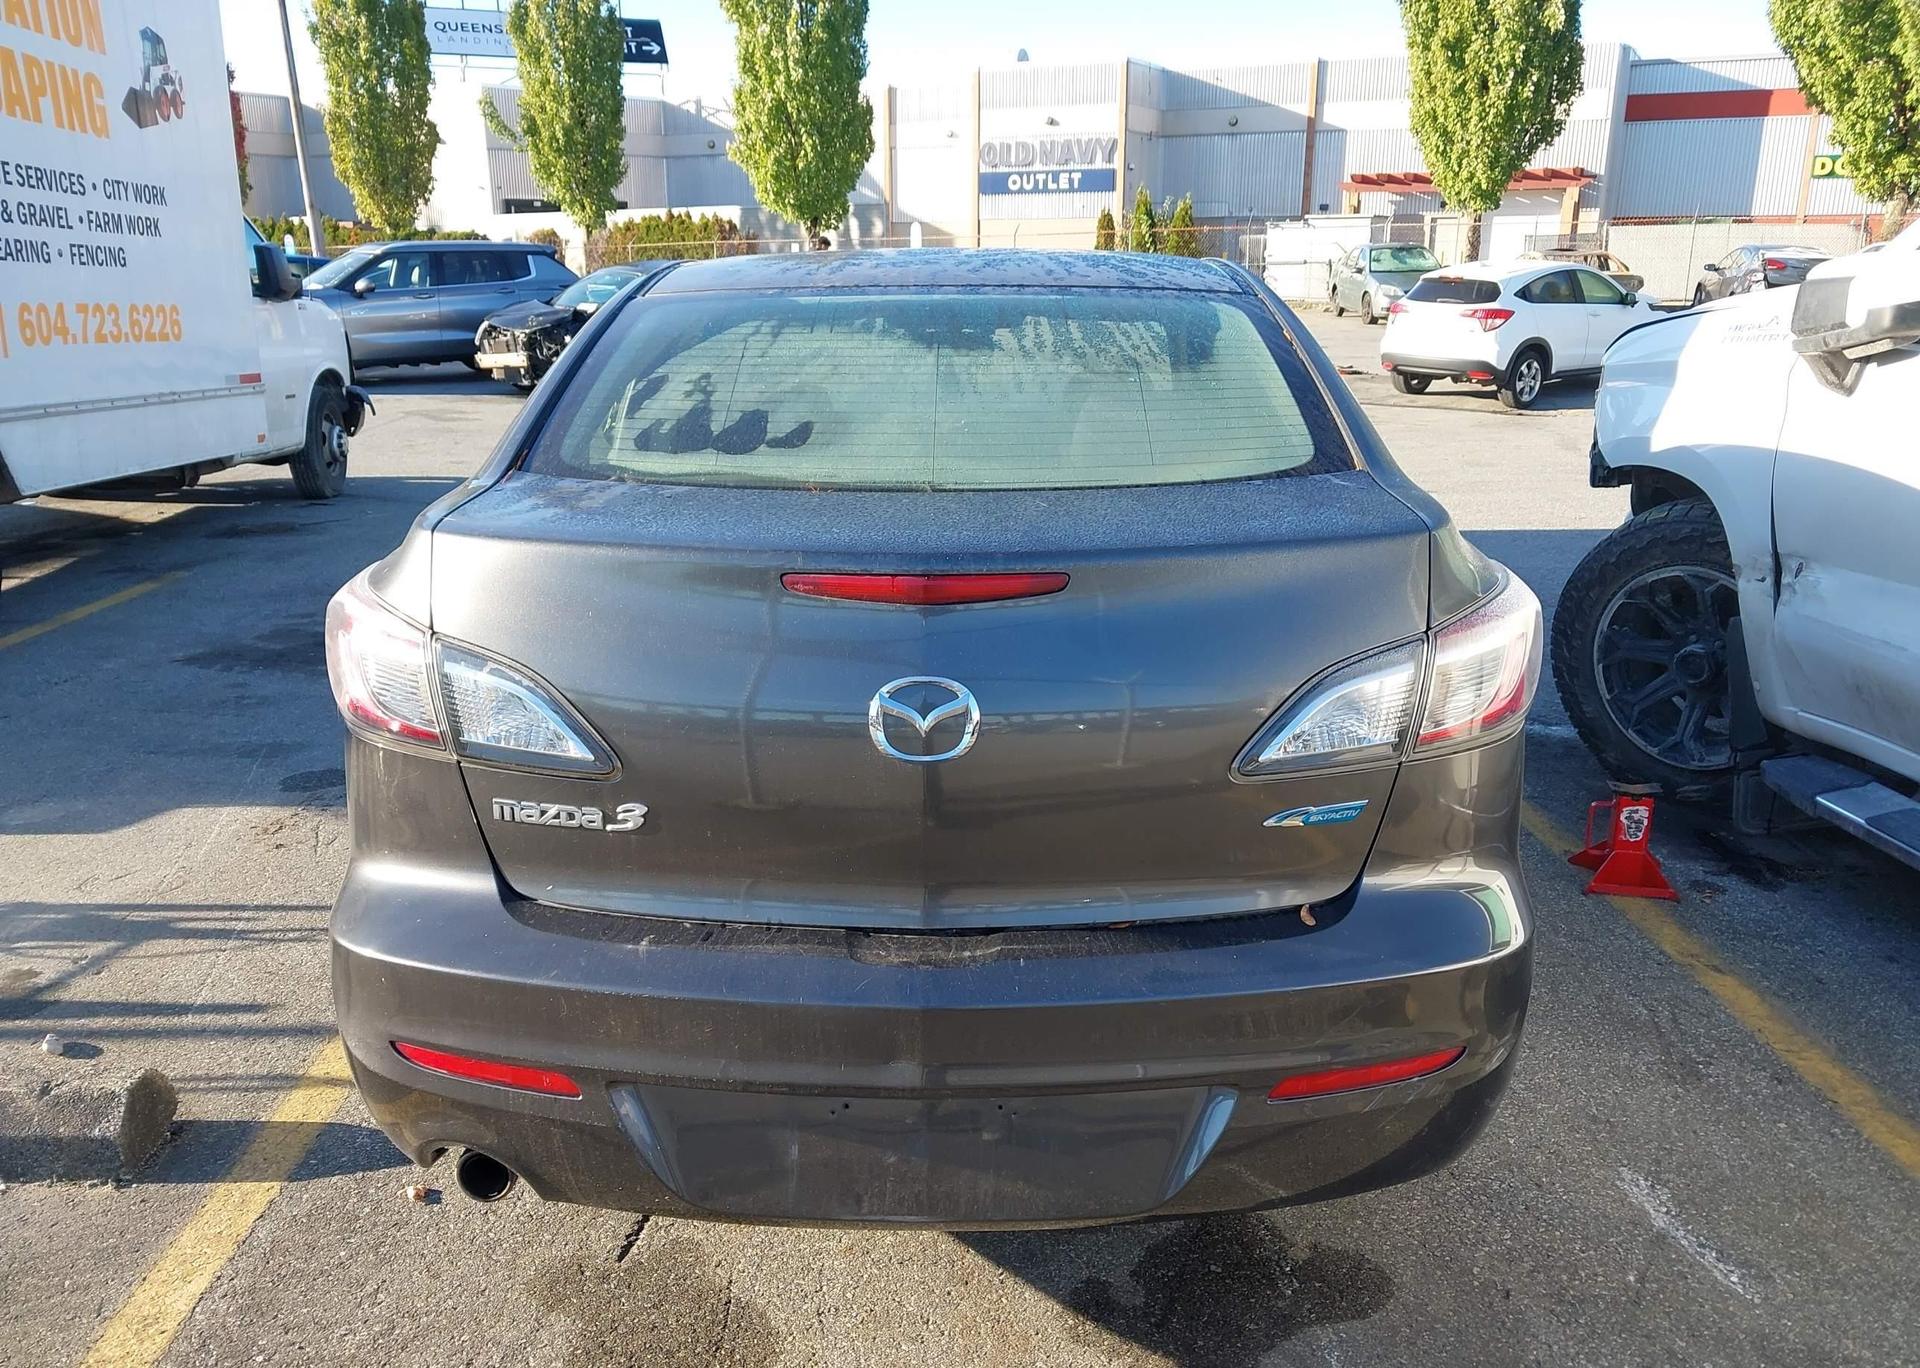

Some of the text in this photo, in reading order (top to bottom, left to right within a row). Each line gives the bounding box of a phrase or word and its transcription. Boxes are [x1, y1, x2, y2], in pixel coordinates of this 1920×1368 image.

[434, 21, 509, 35] QUEENS
[981, 137, 1118, 168] OLD NAVY
[15, 163, 86, 196] SERVICES
[103, 178, 129, 202] CITY
[131, 182, 168, 207] WORK
[1007, 172, 1082, 191] OUTLET
[16, 201, 73, 230] GRAVEL
[86, 209, 123, 235] FARM
[125, 214, 162, 238] WORK
[69, 243, 127, 268] FENCING
[18, 302, 182, 347] 604.723.6226
[1309, 809, 1360, 821] SKYACTIV
